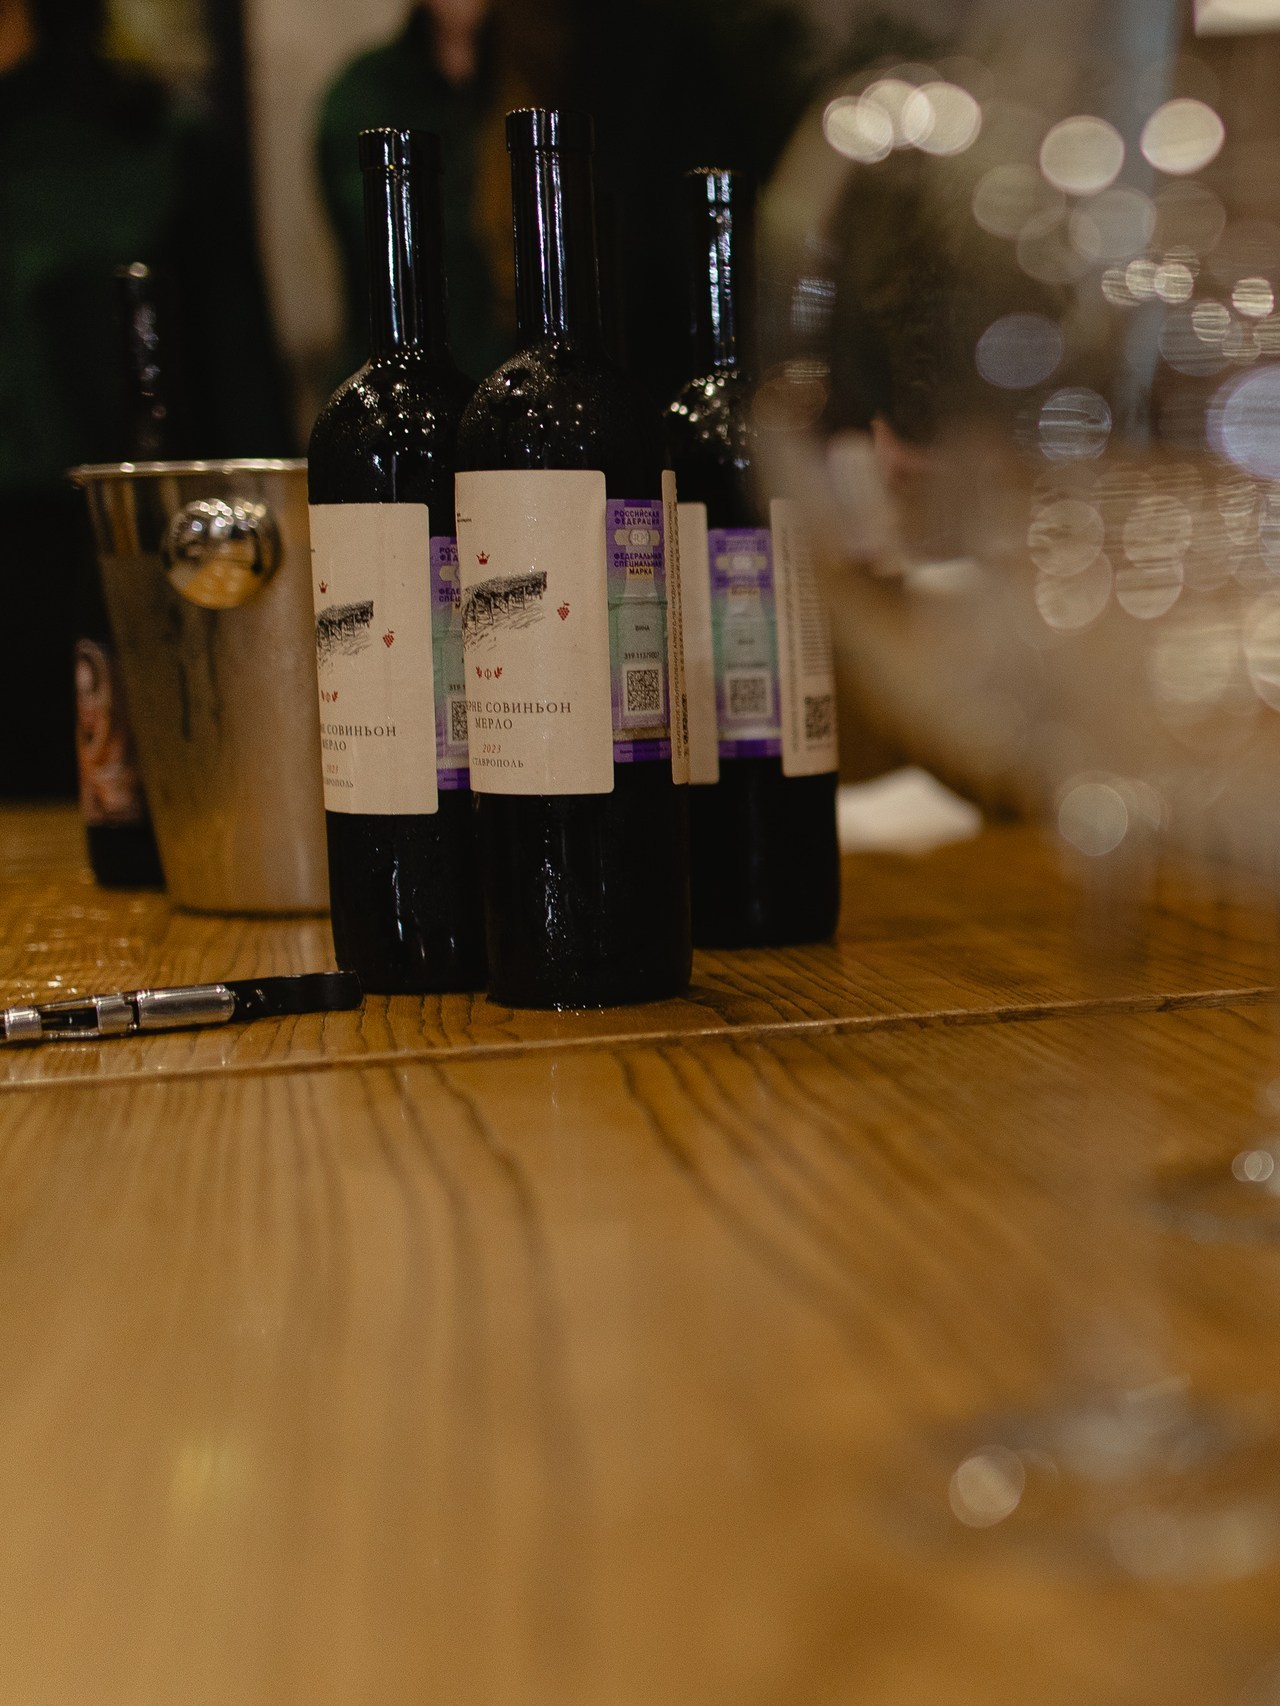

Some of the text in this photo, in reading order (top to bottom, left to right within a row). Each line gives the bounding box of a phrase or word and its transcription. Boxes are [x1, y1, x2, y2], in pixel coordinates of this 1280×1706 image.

[614, 509, 660, 518] РОССИЙСКАЯ
[614, 518, 660, 526] ФЕДЕРАЦИЯ
[613, 552, 662, 560] ФЕДЕРАЛЬНАЯ
[613, 560, 662, 568] СПЕЦИАЛЬНАЯ
[629, 567, 653, 575] МАРКА
[486, 702, 571, 714] СОВИНЬОН
[475, 717, 513, 730] МЕРЛО
[327, 725, 397, 737] СОВИНЬОН
[482, 744, 502, 754] 2023
